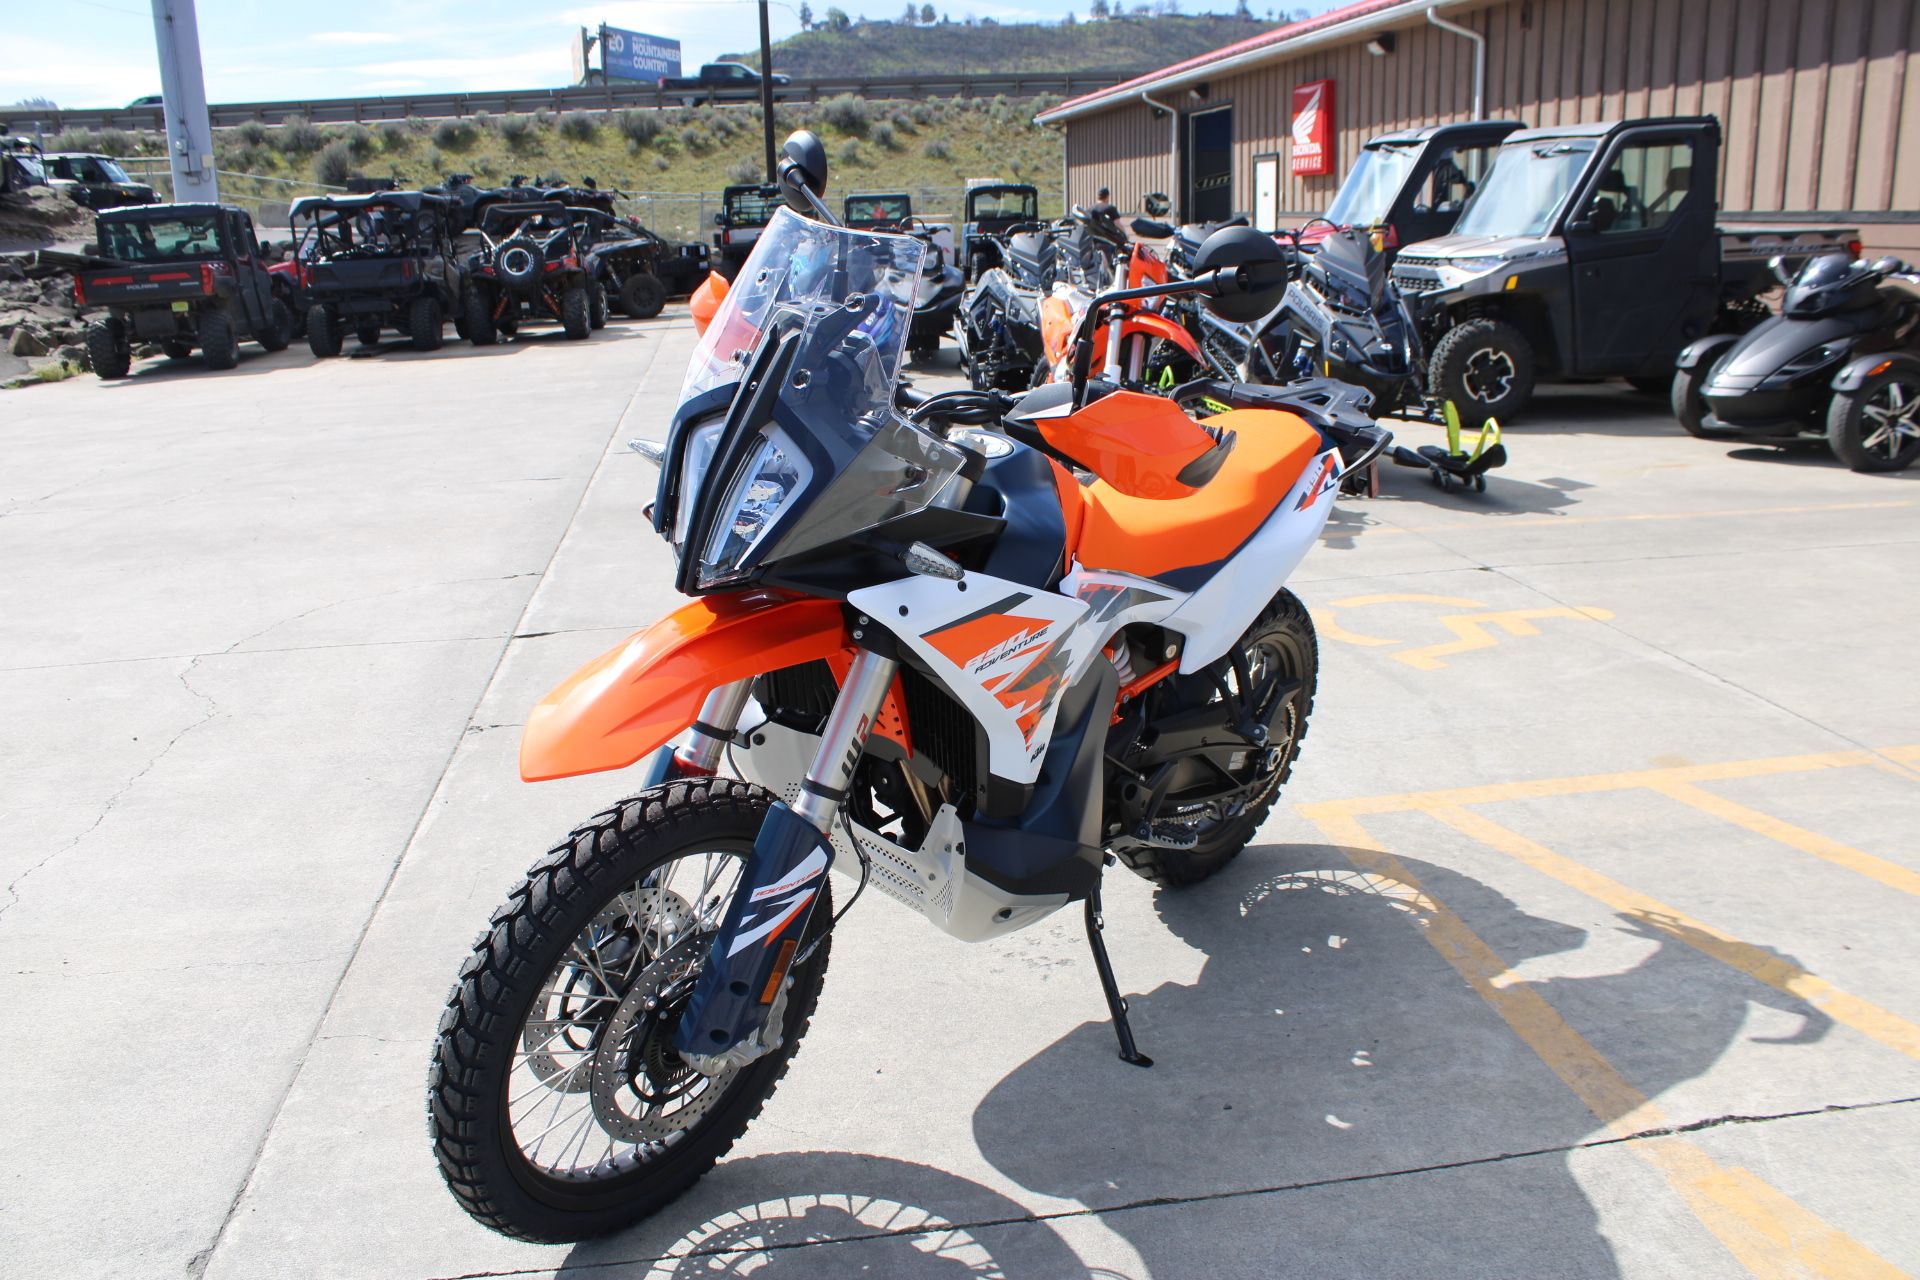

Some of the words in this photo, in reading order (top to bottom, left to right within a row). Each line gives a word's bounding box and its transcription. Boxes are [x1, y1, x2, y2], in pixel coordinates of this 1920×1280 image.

[633, 56, 668, 73] COUNTRY!
[1293, 142, 1322, 156] HONDA
[1292, 155, 1322, 171] SERVICE
[1288, 289, 1324, 329] POLARIS
[974, 627, 1049, 674] ADVENTURE
[1030, 742, 1045, 763] KTM
[755, 866, 823, 897] ADVENTURE
